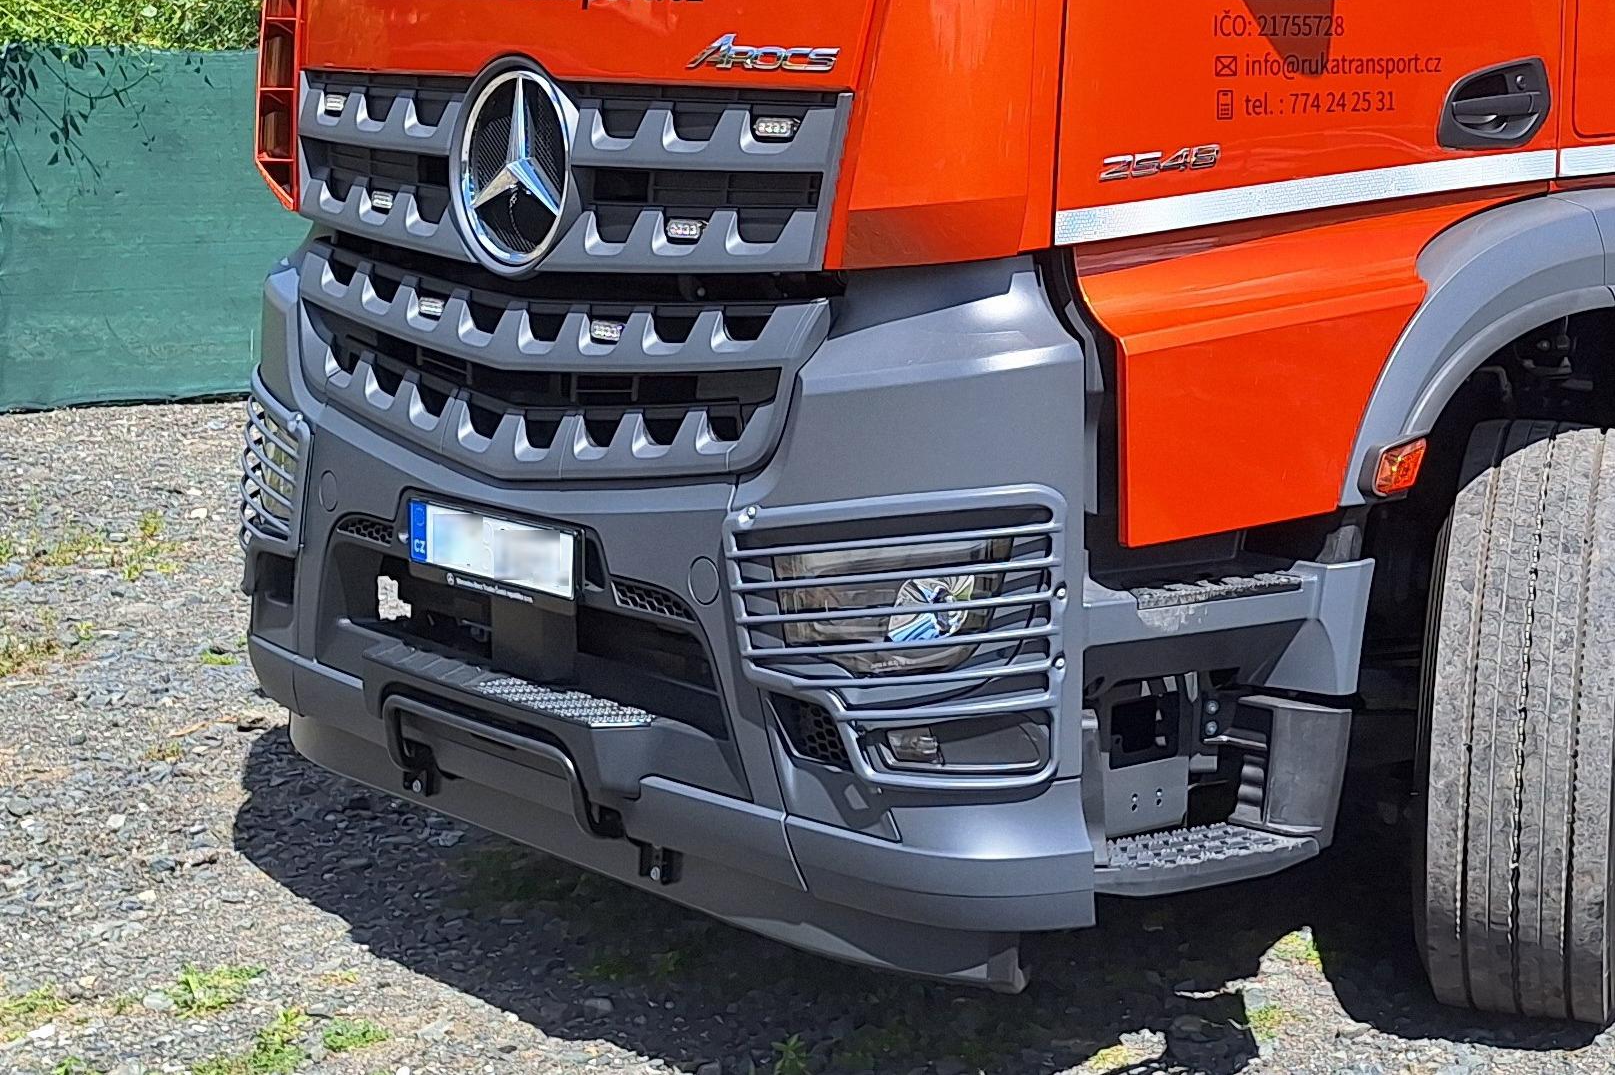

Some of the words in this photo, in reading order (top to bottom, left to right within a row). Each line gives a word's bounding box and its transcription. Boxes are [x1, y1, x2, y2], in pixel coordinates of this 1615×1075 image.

[1213, 9, 1253, 37] IČO:
[1257, 15, 1345, 37] 21755728
[1244, 51, 1442, 80] info@rukatransport.cz
[1289, 92, 1322, 115] 774
[1325, 91, 1347, 113] 24
[1351, 90, 1372, 113] 25
[1376, 90, 1396, 112] 31
[1098, 143, 1222, 182] 2548
[413, 538, 426, 554] CZ
